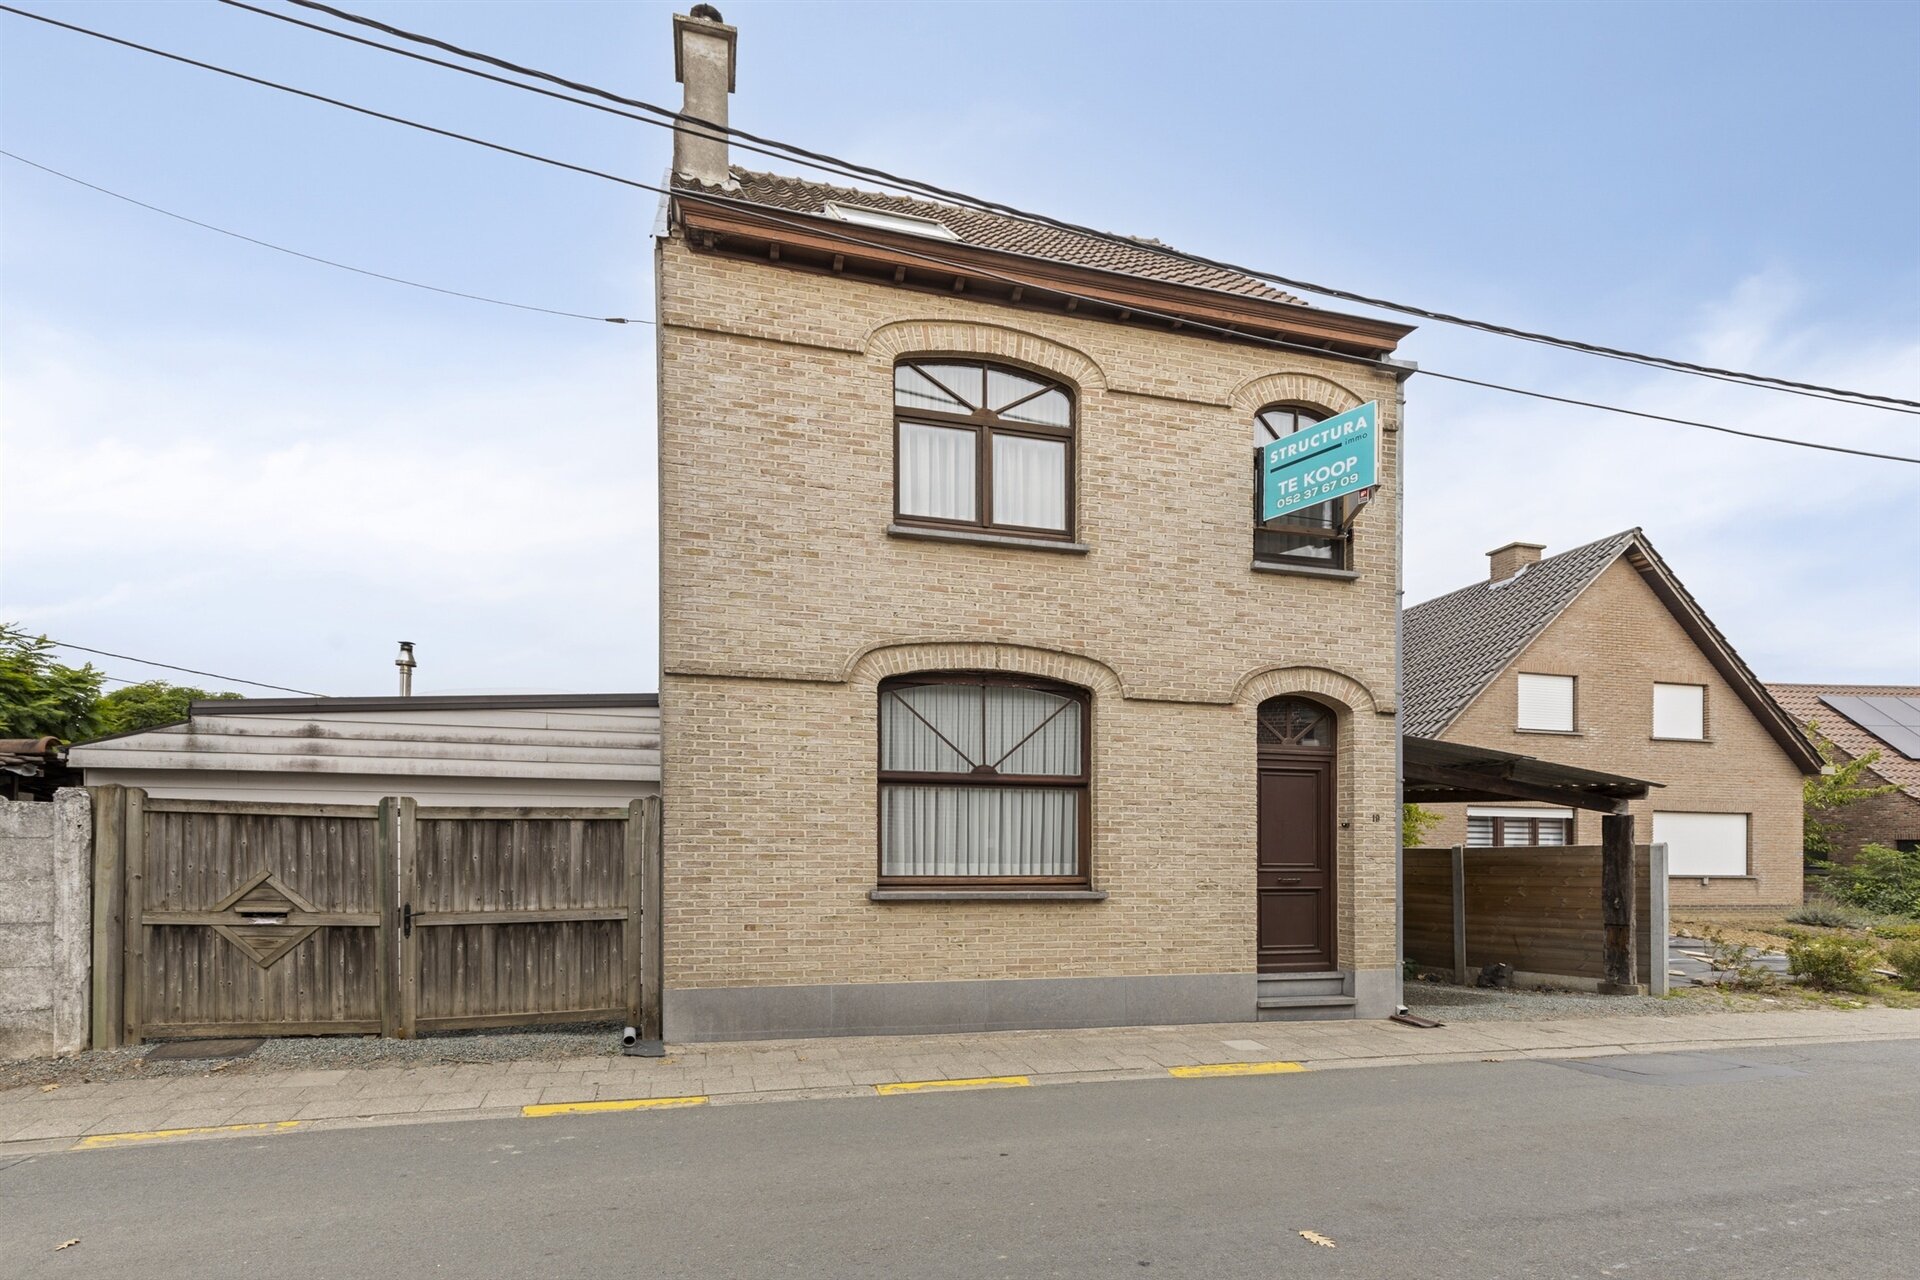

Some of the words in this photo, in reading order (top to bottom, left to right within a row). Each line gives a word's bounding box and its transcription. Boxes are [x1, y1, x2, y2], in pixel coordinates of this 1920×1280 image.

[1270, 416, 1368, 464] STRUCTURA
[1344, 432, 1368, 445] immo
[1277, 494, 1300, 508] 052
[1304, 487, 1318, 499] 37
[1321, 481, 1337, 493] 67
[1340, 473, 1359, 487] 09
[1278, 477, 1298, 495] TE
[1304, 456, 1358, 487] KOOP
